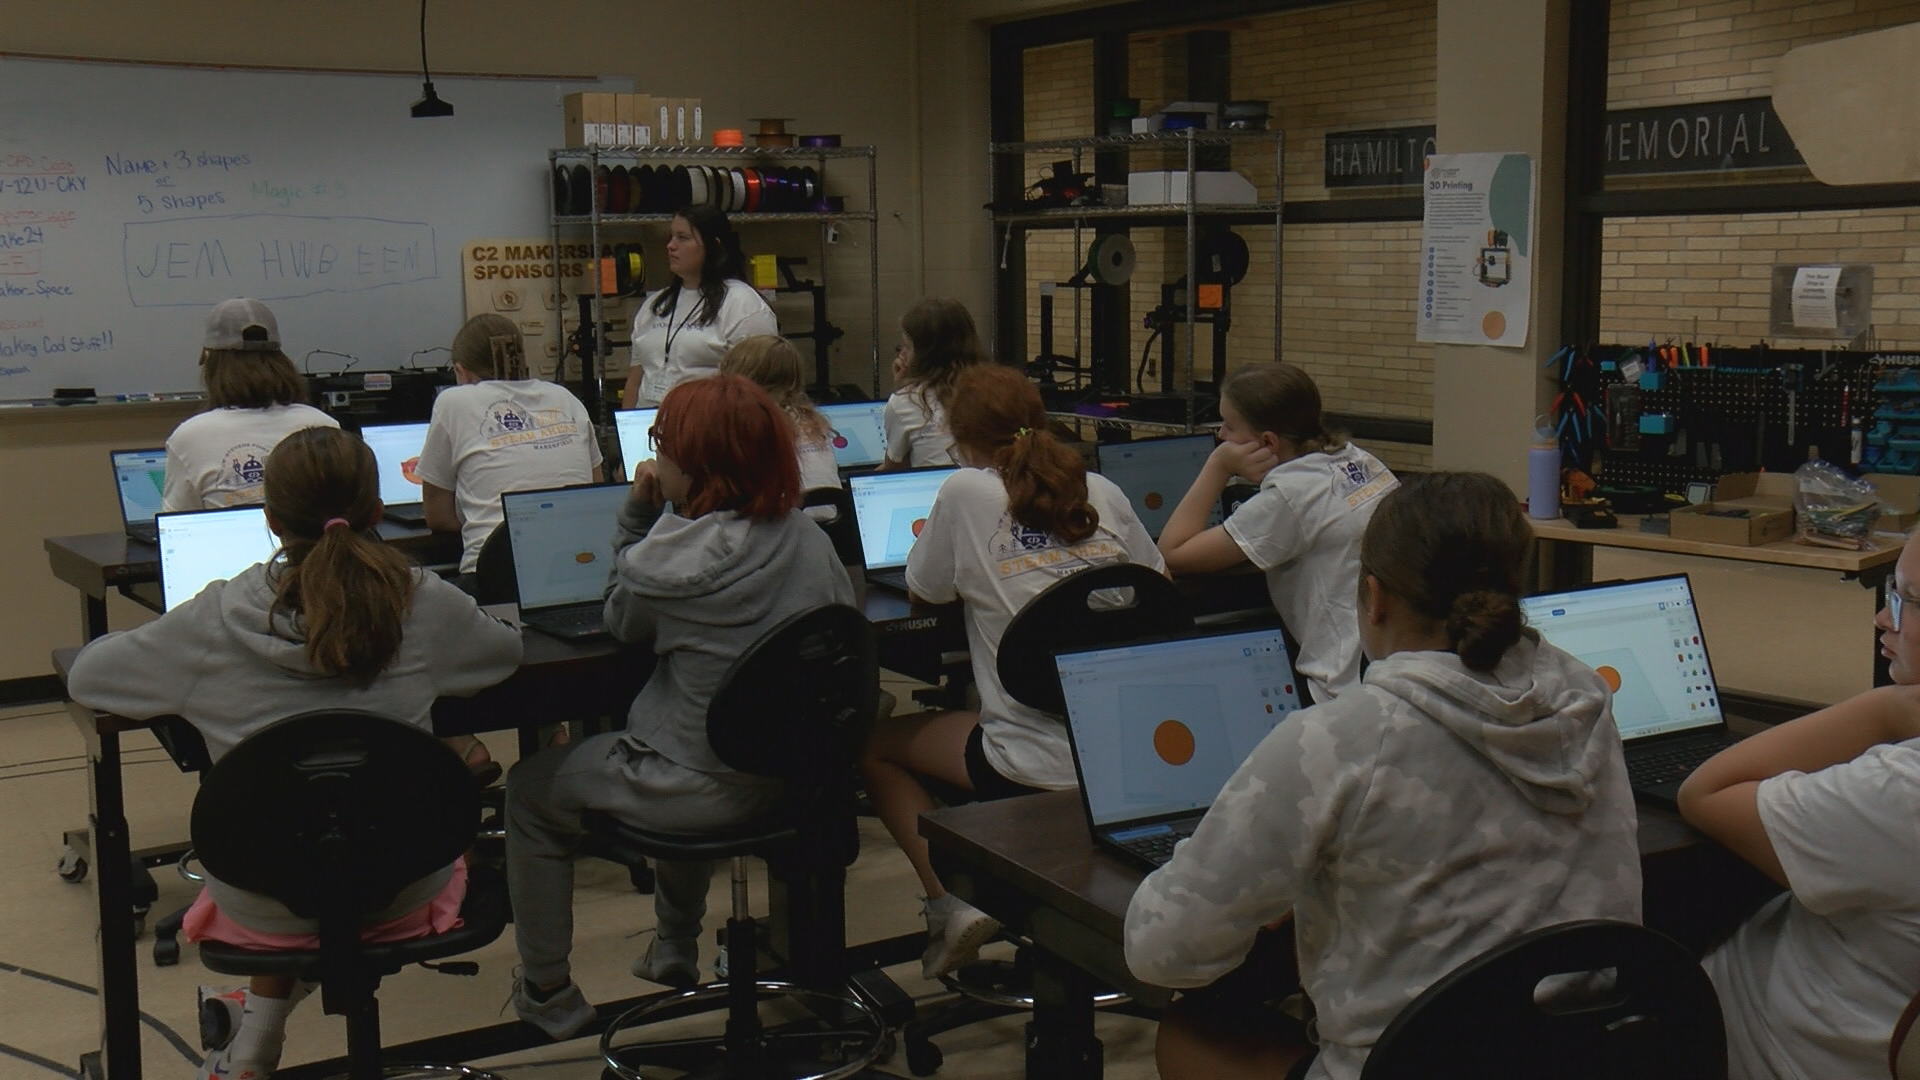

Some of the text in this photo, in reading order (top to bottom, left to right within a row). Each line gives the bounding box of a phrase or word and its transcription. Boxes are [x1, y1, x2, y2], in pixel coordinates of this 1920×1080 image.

[105, 152, 157, 176] Name
[174, 150, 191, 169] 3
[196, 151, 251, 171] shapes
[1429, 181, 1473, 192] 3D Printing
[136, 195, 154, 214] 5
[136, 239, 233, 279] JEM
[257, 240, 338, 280] HWB
[472, 246, 499, 261] C2
[473, 263, 585, 281] SPONSORS
[900, 616, 938, 631] HUSKY
